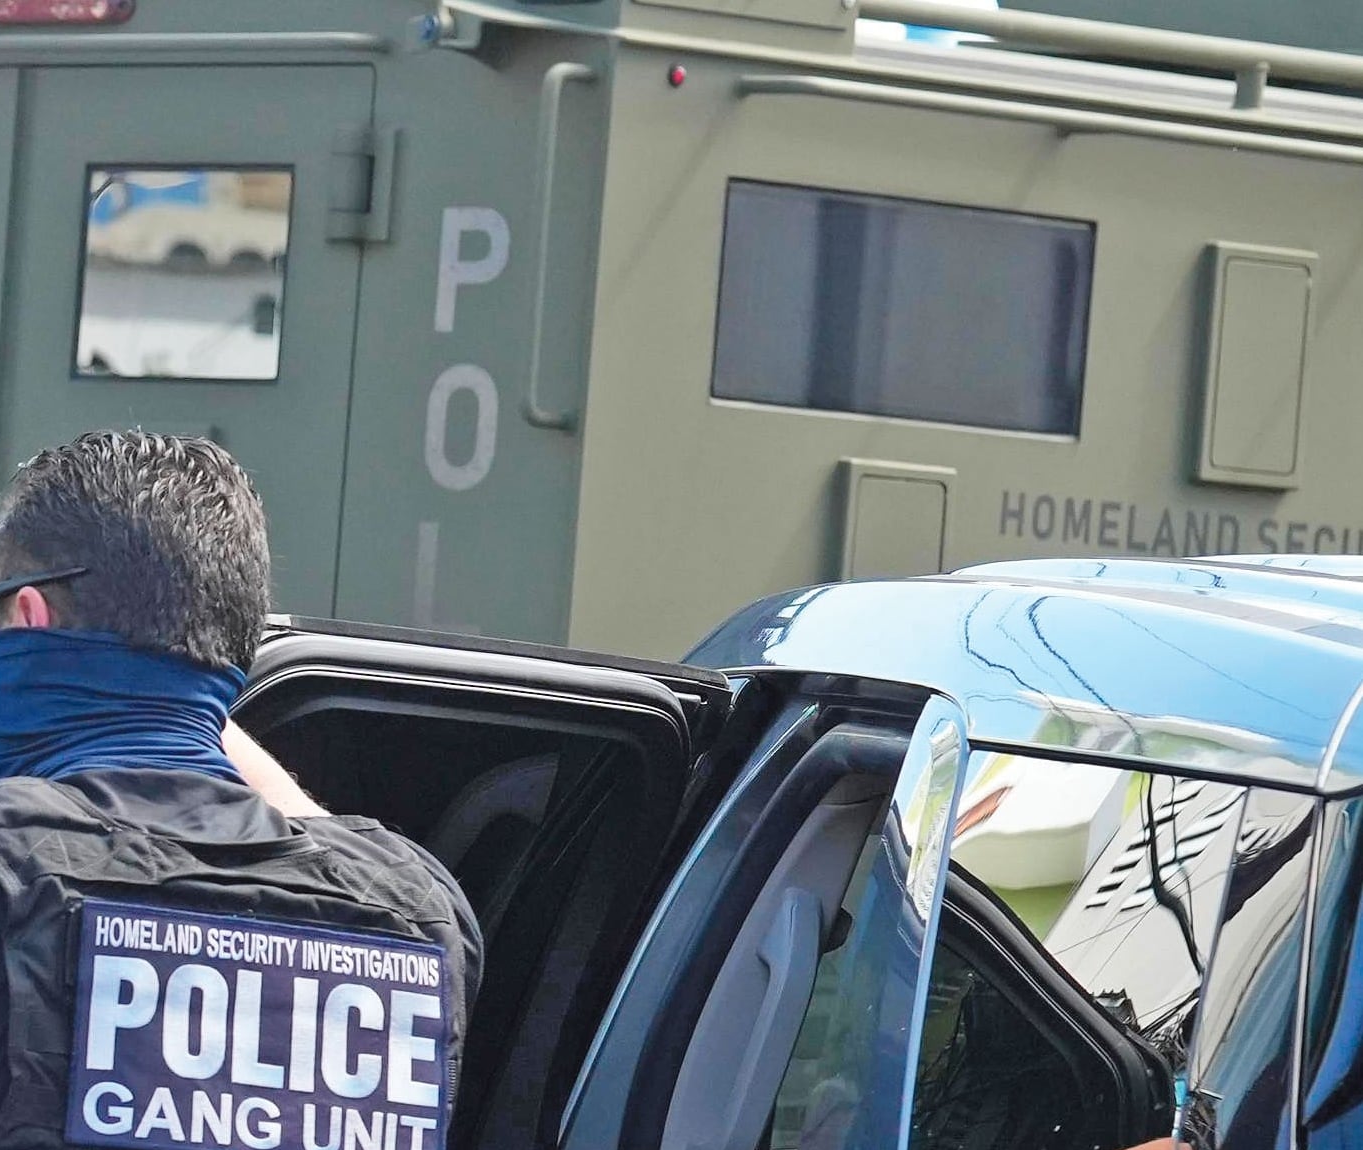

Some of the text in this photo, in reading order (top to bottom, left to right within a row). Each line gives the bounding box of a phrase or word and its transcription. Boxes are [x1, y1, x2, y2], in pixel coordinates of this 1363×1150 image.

[999, 490, 1241, 557] HOMELAND
[95, 916, 440, 988] HOMELAND SECURITY INVESTIGATIONS
[85, 954, 442, 1108] POLICE
[82, 1081, 282, 1150] GANG
